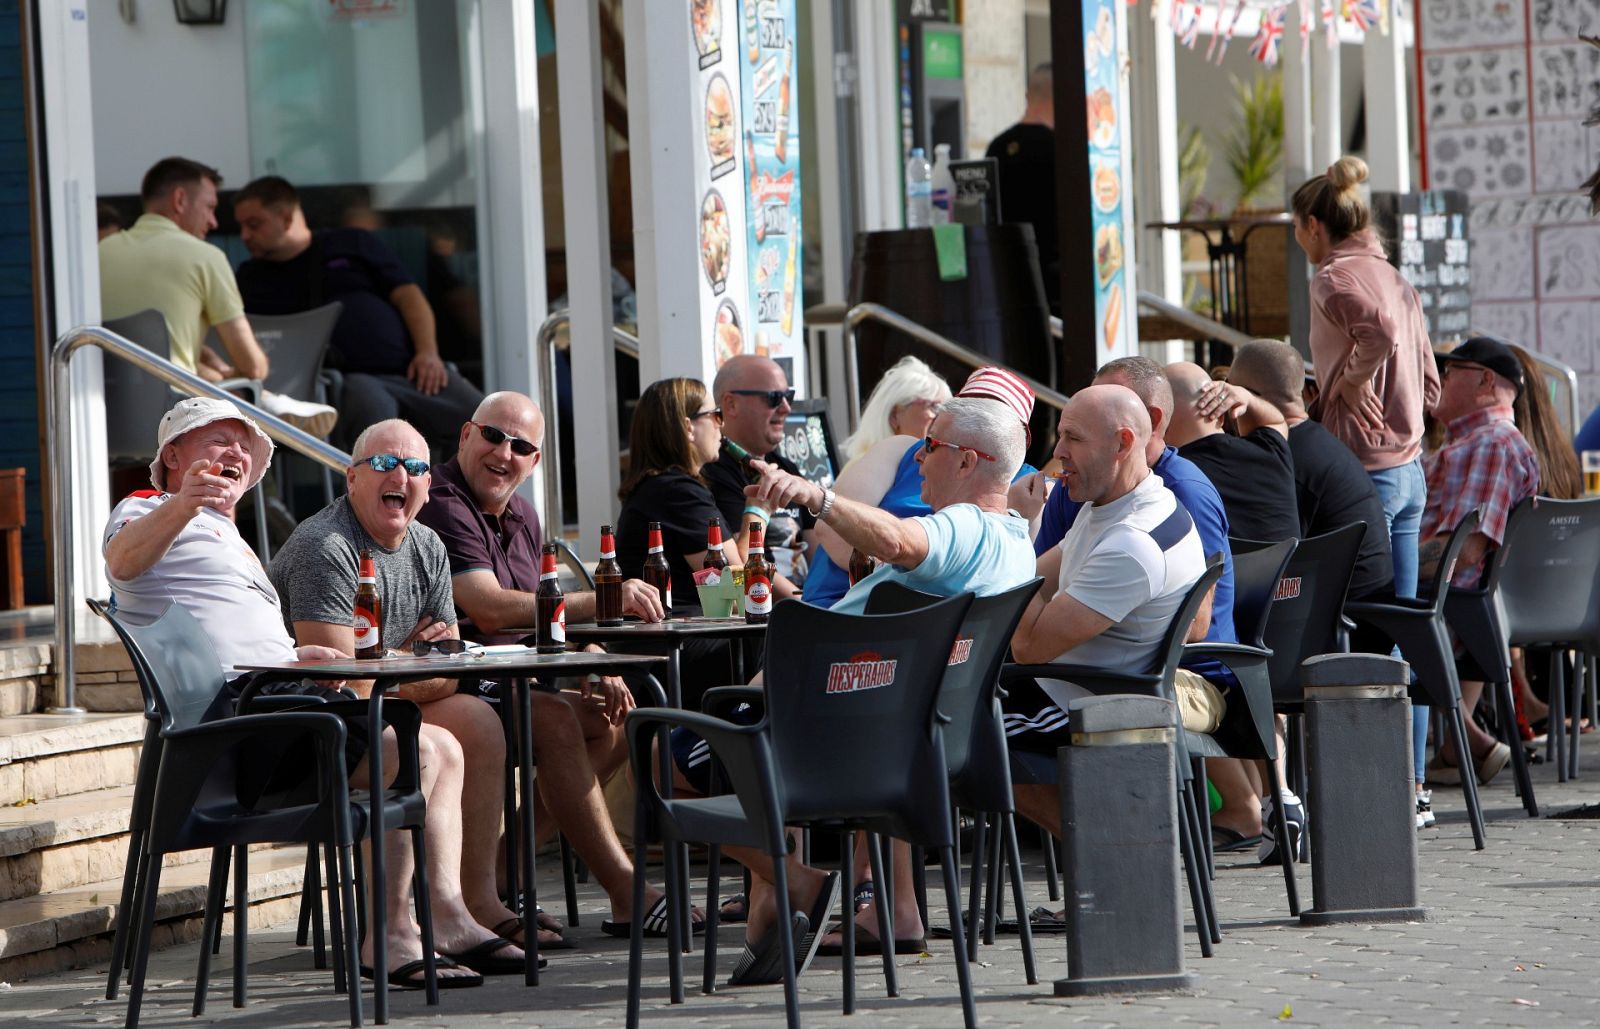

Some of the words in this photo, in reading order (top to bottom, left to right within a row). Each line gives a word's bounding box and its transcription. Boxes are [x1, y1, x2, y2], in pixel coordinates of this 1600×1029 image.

[956, 168, 986, 180] MENU
[1549, 516, 1580, 525] AMSTEL
[826, 660, 897, 693] DESPERADOS
